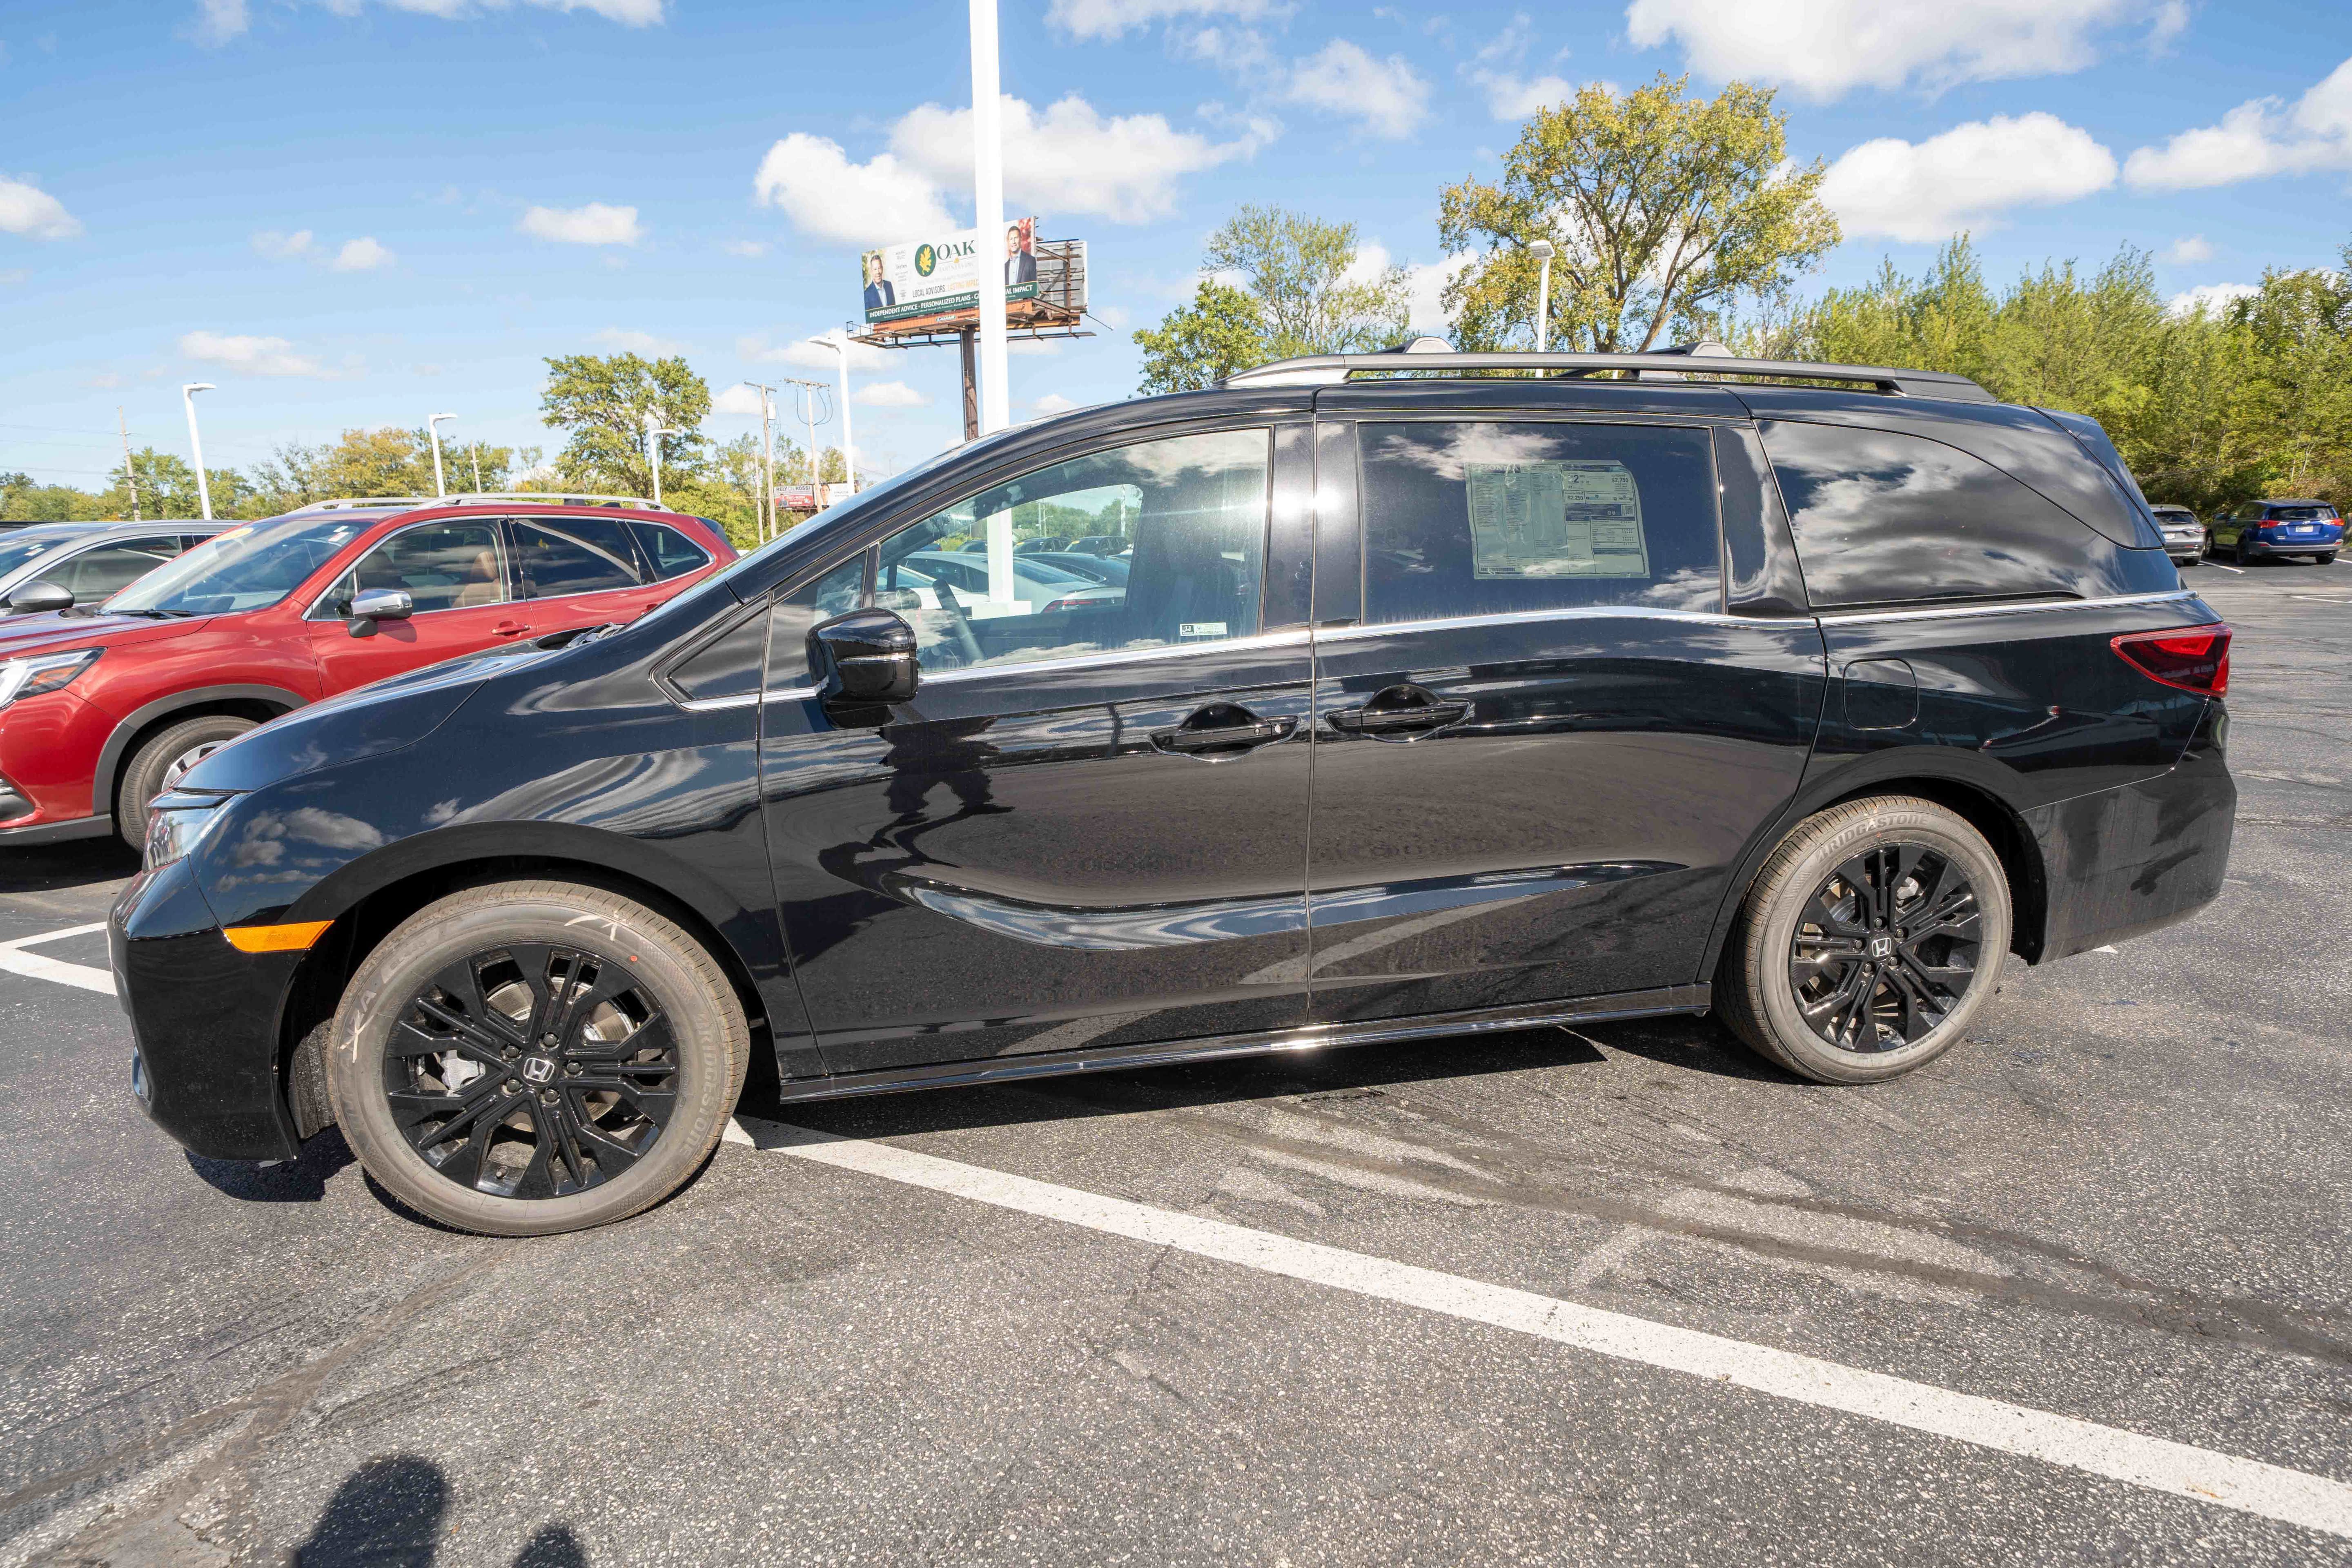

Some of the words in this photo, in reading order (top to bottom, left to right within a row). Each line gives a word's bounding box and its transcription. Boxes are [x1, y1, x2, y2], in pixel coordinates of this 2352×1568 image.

[937, 240, 976, 260] OAK
[913, 289, 925, 298] LOCAL
[1013, 285, 1033, 293] IMPACT
[869, 307, 901, 318] INDEPENDENT
[901, 304, 918, 312] ADVICE
[921, 297, 955, 309] PERSONALIZED
[956, 294, 971, 302] PLANS
[679, 1011, 717, 1156] BRIDGESTONE
